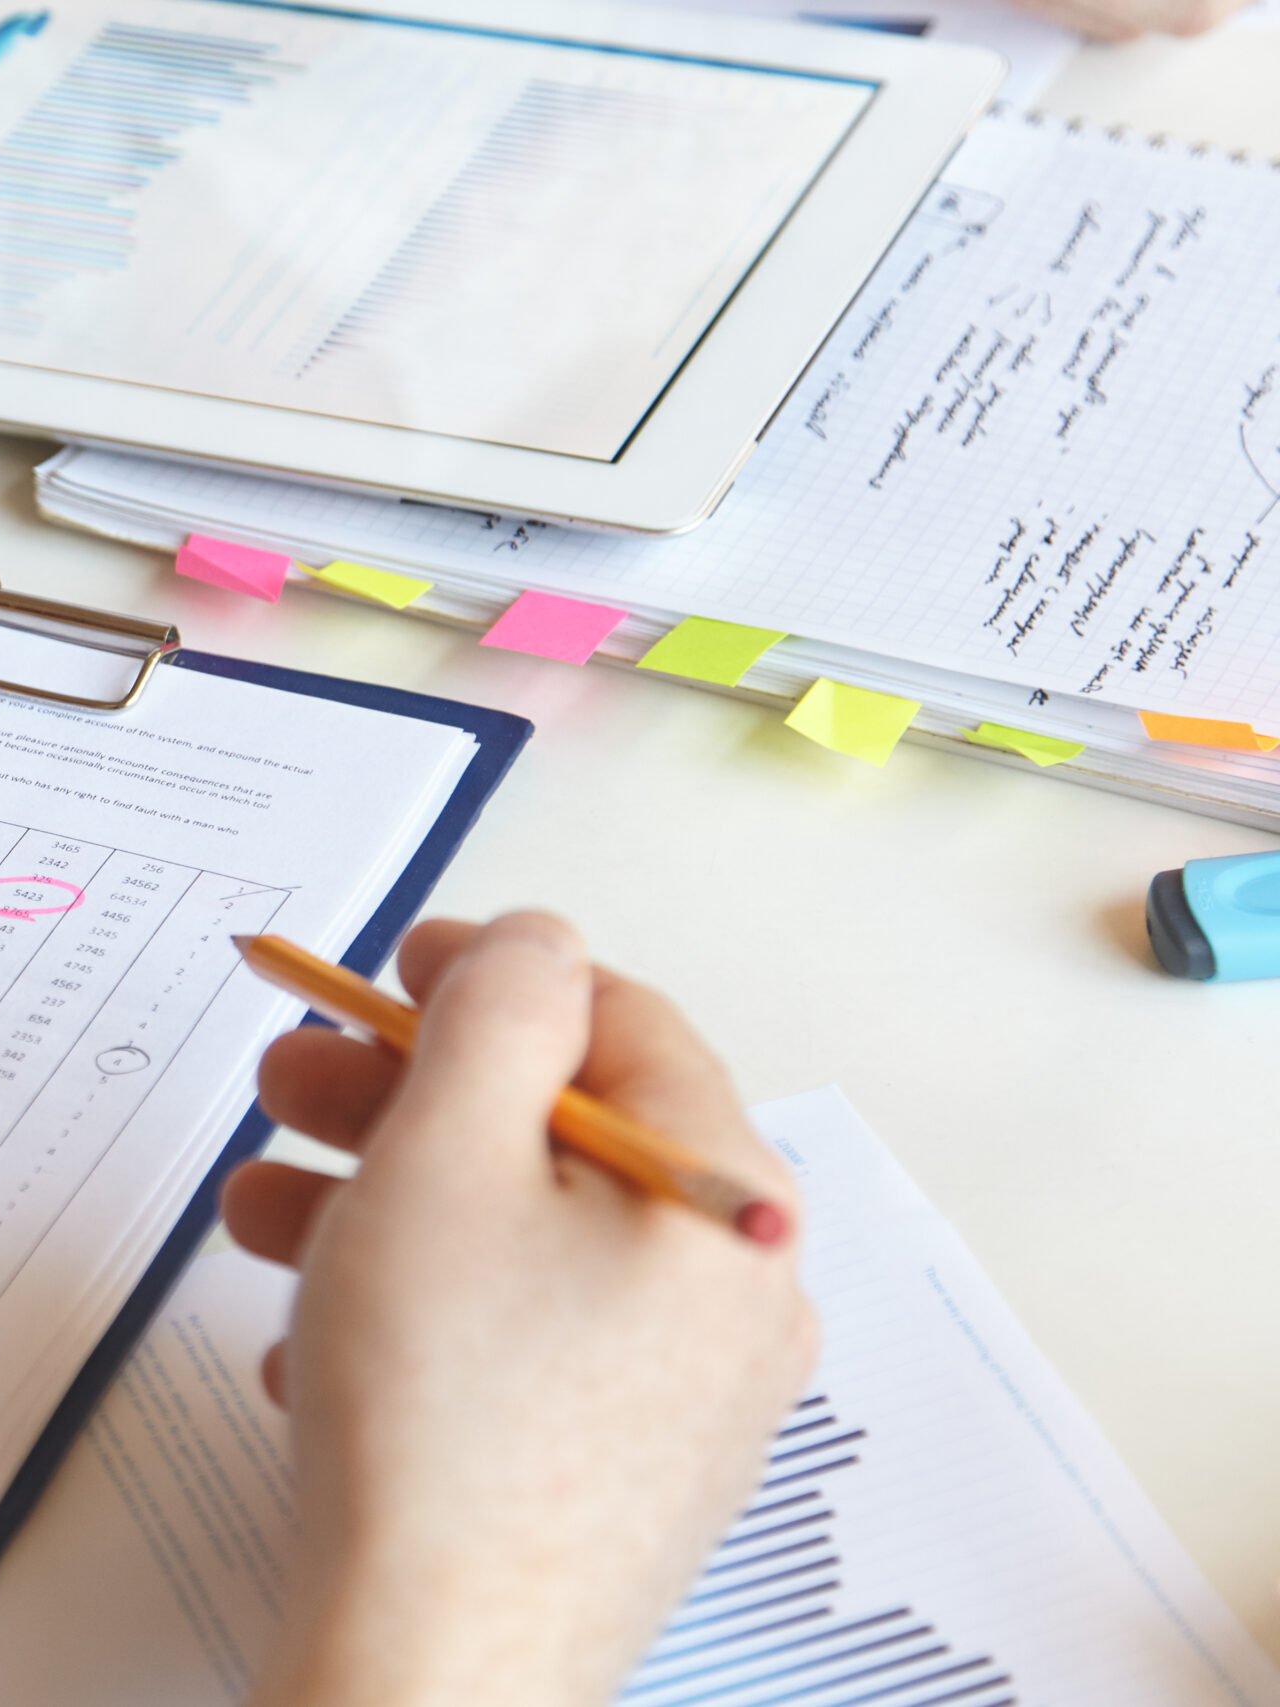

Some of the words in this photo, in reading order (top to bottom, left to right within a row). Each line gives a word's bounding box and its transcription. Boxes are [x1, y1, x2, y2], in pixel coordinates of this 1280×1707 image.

[8, 700, 26, 709] you
[37, 708, 83, 723] complete
[84, 718, 124, 732] account
[138, 730, 155, 739] the
[196, 744, 217, 753] and
[217, 749, 262, 764] expound
[262, 759, 280, 768] the
[281, 764, 314, 775] actual
[14, 734, 58, 748] pleasure
[59, 744, 106, 760] rationally
[107, 756, 159, 773] encounter
[160, 769, 229, 790] consequences
[232, 785, 254, 795] that
[3, 741, 45, 756] because
[45, 752, 106, 771] occasionally
[106, 766, 176, 788] circumstances
[178, 784, 207, 795] occur
[220, 794, 250, 805] which
[252, 801, 270, 809] toil
[10, 776, 33, 785] who
[34, 780, 51, 789] has
[52, 786, 72, 795] any
[73, 791, 97, 800] right
[99, 796, 111, 804] to
[112, 799, 133, 810] find
[134, 805, 157, 816] fault
[159, 812, 181, 822] with
[192, 820, 215, 829] man
[217, 826, 239, 835] who
[51, 841, 80, 853] 3465
[141, 863, 164, 874] 256
[38, 856, 69, 869] 2342
[121, 876, 159, 891] 34562
[13, 888, 44, 902] 5423
[100, 910, 131, 923] 4456
[109, 892, 147, 907] 64534
[88, 926, 118, 940] 3245
[75, 943, 105, 957] 2745
[63, 961, 93, 974] 4745
[50, 978, 82, 991] 4567
[40, 995, 66, 1008] 237
[27, 1013, 52, 1026] 654
[10, 1029, 42, 1045] 2353
[1, 1048, 26, 1061] 342
